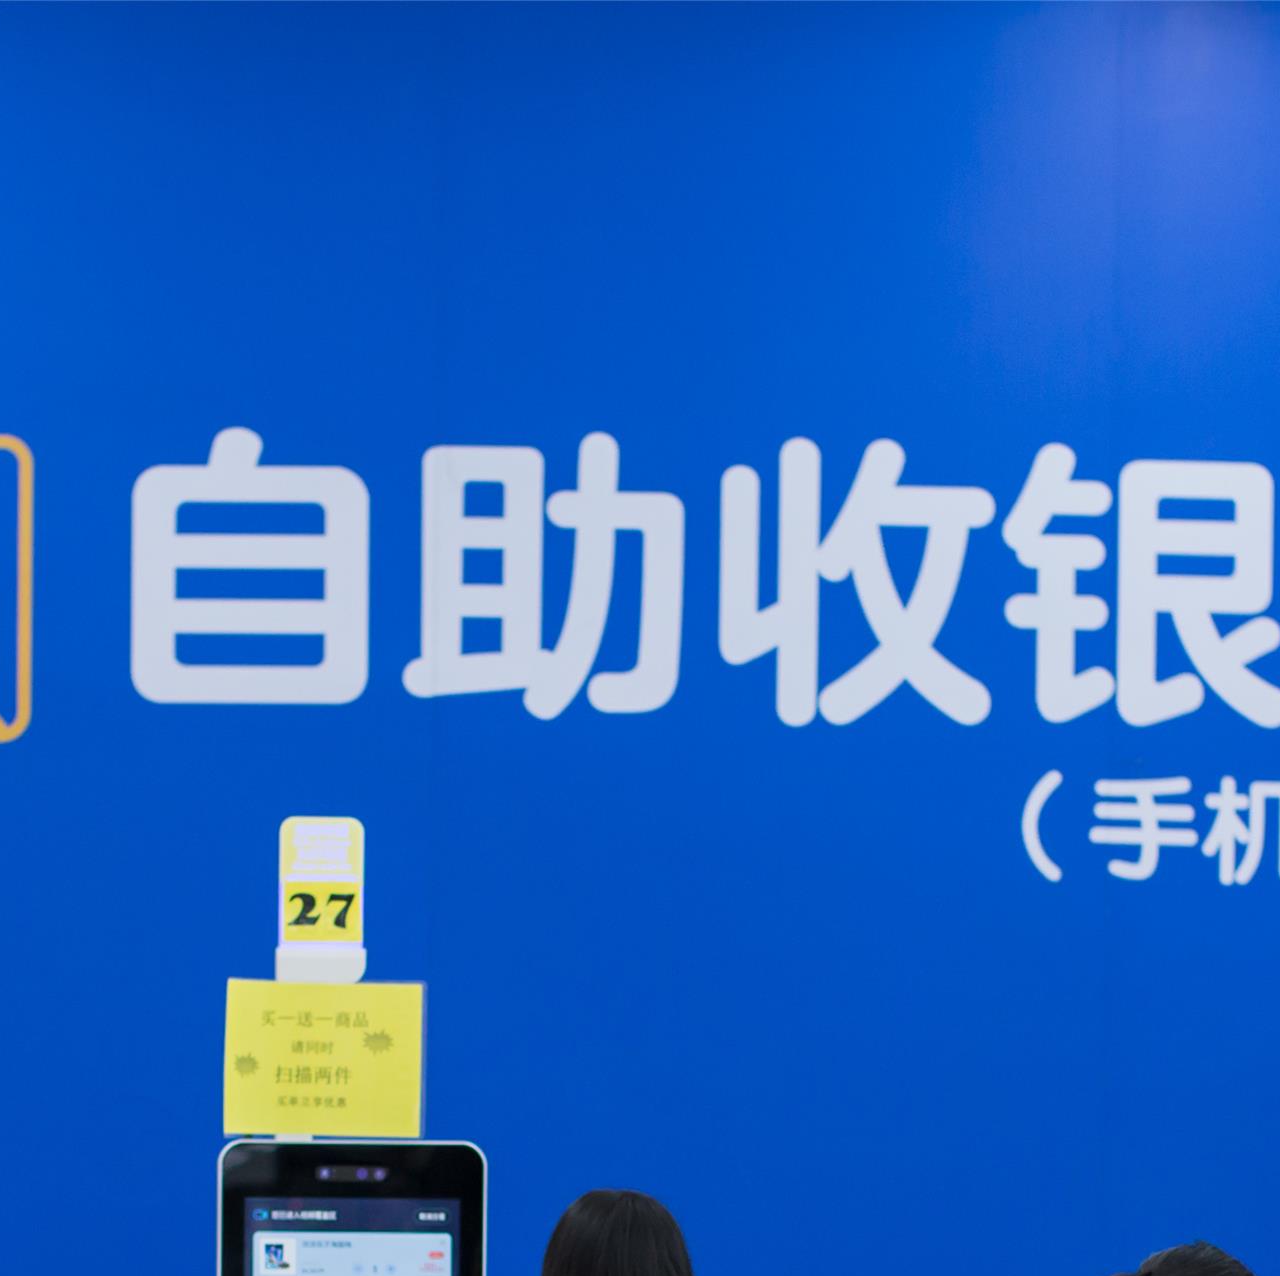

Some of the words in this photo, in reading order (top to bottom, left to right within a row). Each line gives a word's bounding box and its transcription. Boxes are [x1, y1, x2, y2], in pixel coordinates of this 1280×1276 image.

[288, 892, 356, 929] 27
[261, 1010, 369, 1028] 买一送一商品
[275, 1066, 352, 1085] 扫描两件
